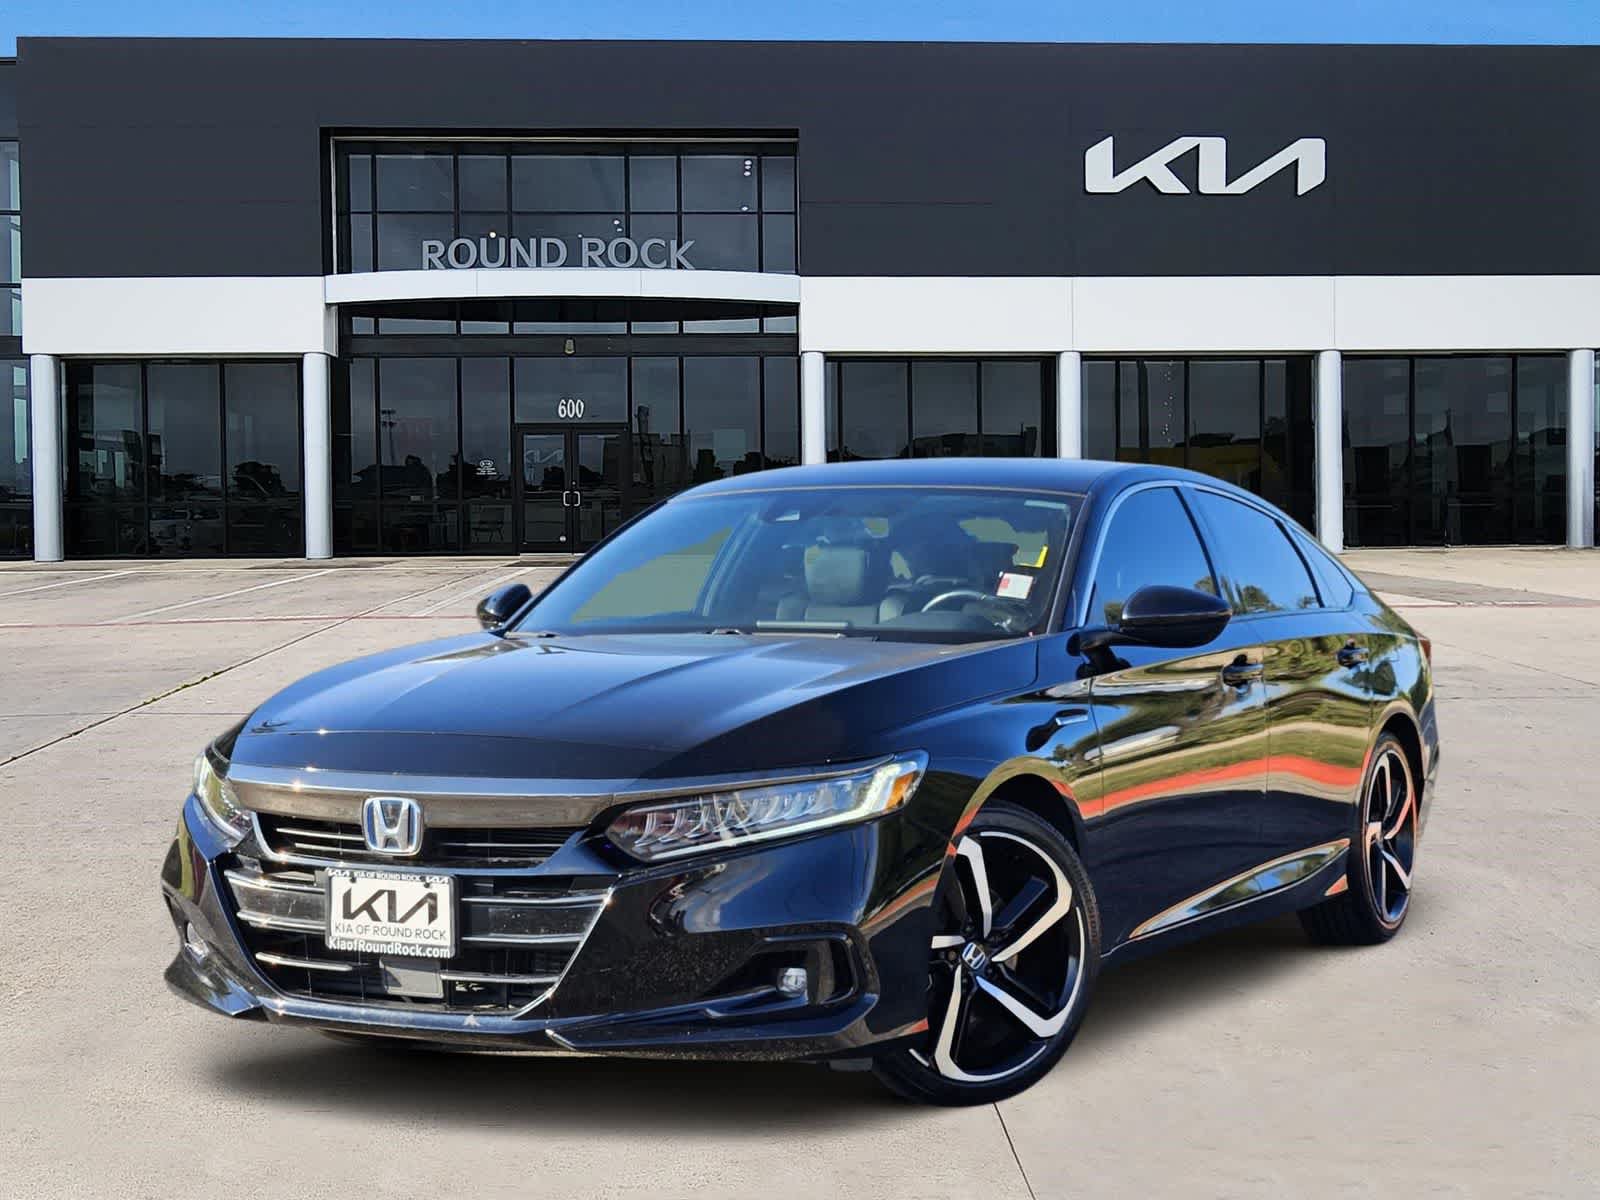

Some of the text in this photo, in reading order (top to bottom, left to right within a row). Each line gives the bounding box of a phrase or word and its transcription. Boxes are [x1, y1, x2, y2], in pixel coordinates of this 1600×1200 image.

[1084, 135, 1326, 196] KIA
[421, 237, 696, 270] ROUND ROCK
[557, 399, 585, 419] 600
[342, 887, 438, 925] KIA
[335, 922, 447, 941] KIA OF ROUND ROCK
[328, 936, 451, 959] KiaofRoundRock.com
